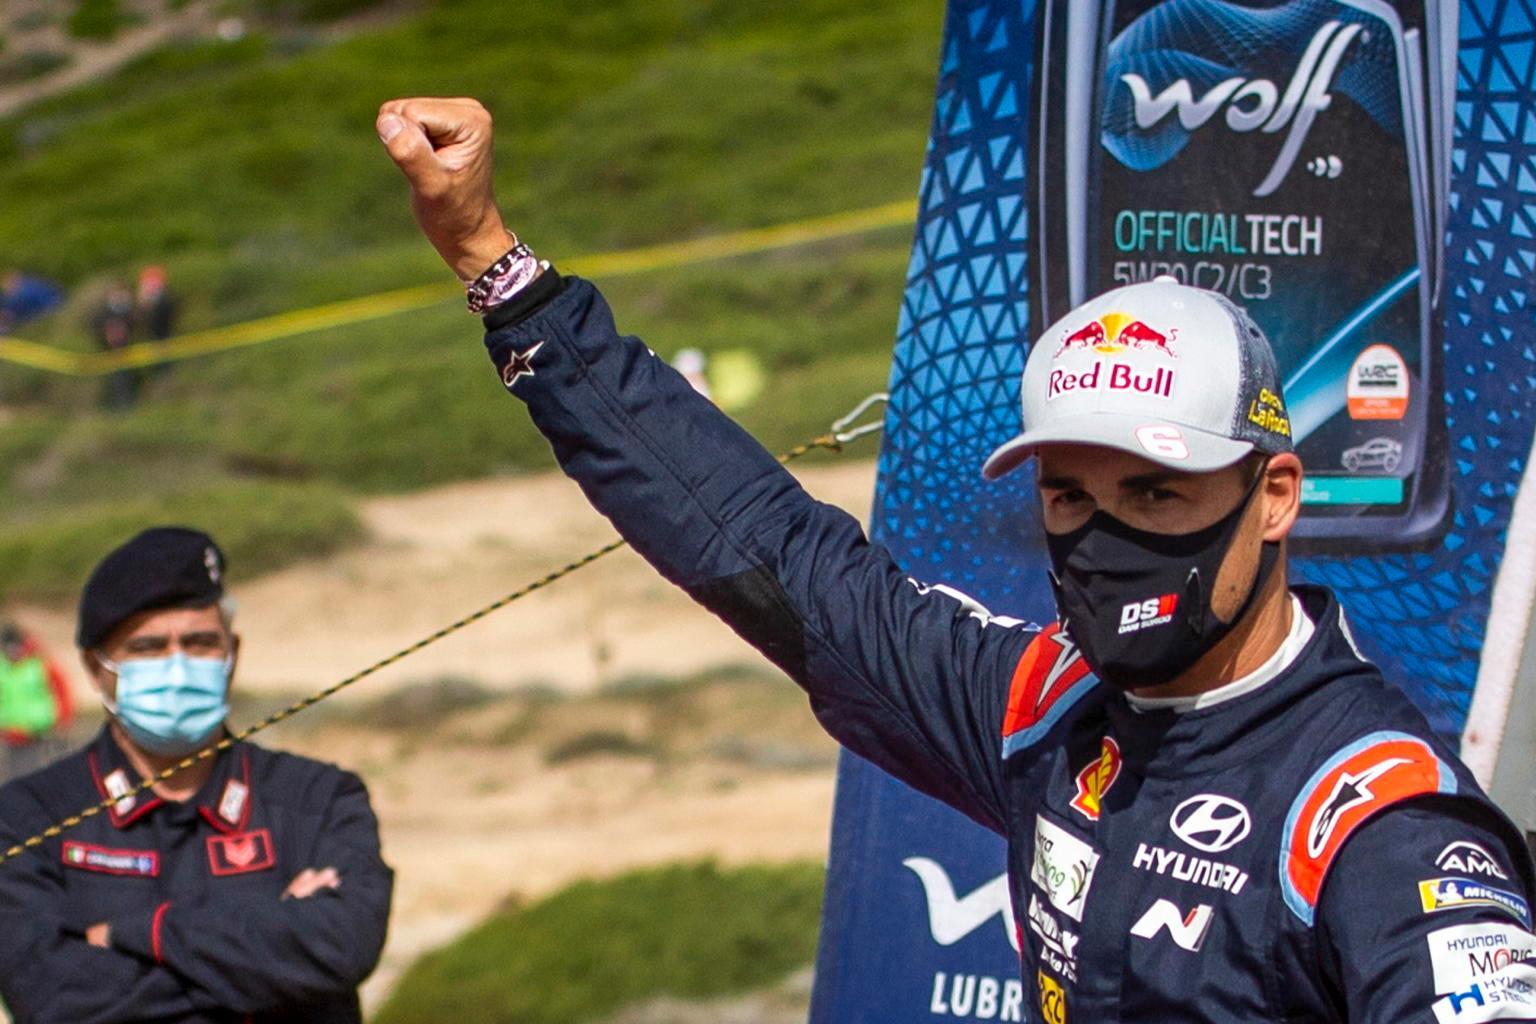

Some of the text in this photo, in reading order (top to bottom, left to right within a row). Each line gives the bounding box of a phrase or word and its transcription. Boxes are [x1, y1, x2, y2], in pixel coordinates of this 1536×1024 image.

[1115, 210, 1323, 256] OFFICIALTECH
[1192, 262, 1273, 300] C2/C3
[1048, 362, 1174, 398] Red Bull
[1359, 364, 1398, 379] WRC
[1121, 598, 1160, 626] DS
[1132, 843, 1249, 895] HYUNDAI
[1464, 886, 1528, 917] MICHELIN
[1447, 934, 1508, 951] HYUNDAI
